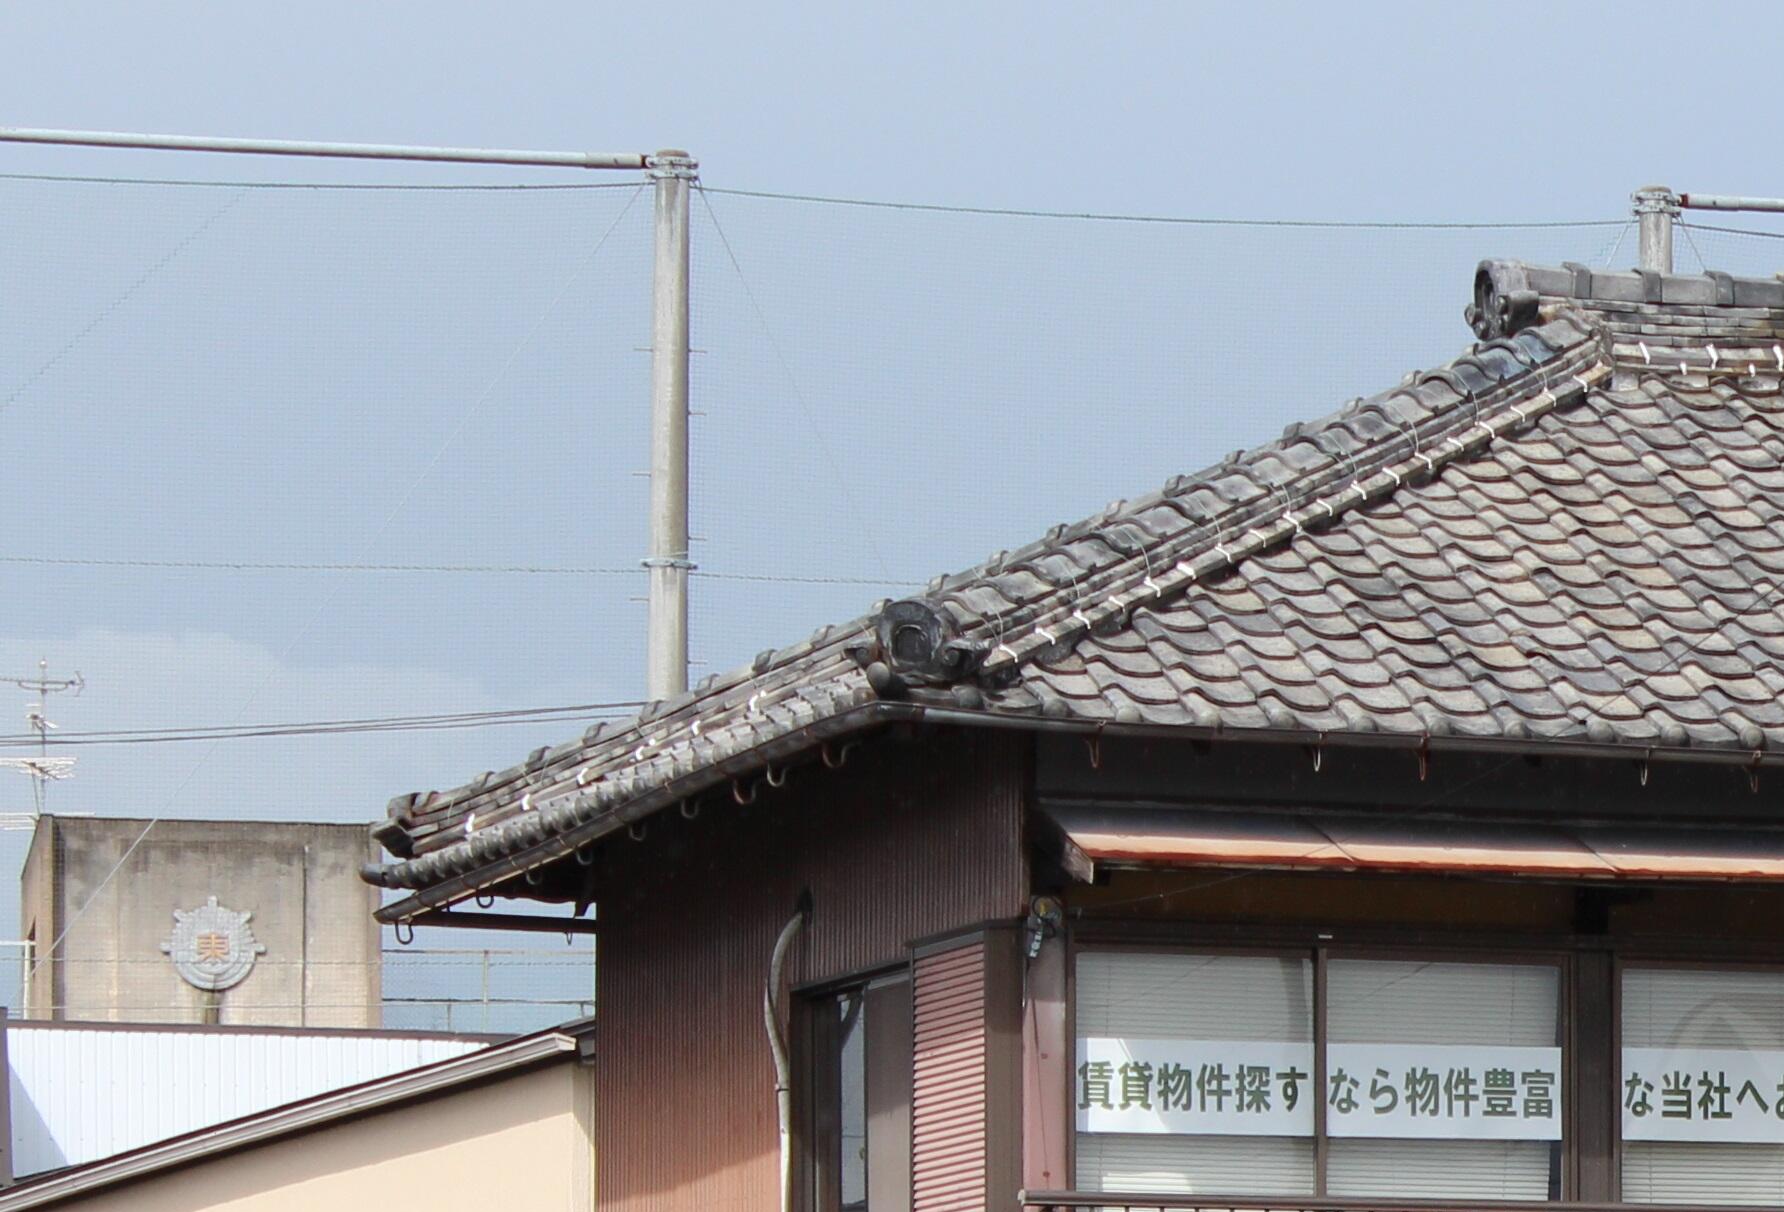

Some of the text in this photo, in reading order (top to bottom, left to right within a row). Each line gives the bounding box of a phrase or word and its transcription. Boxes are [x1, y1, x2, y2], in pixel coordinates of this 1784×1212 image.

[197, 933, 231, 961] 東
[1077, 1060, 1308, 1113] 賃貸物件探す
[1329, 1067, 1555, 1119] なら物件豊富
